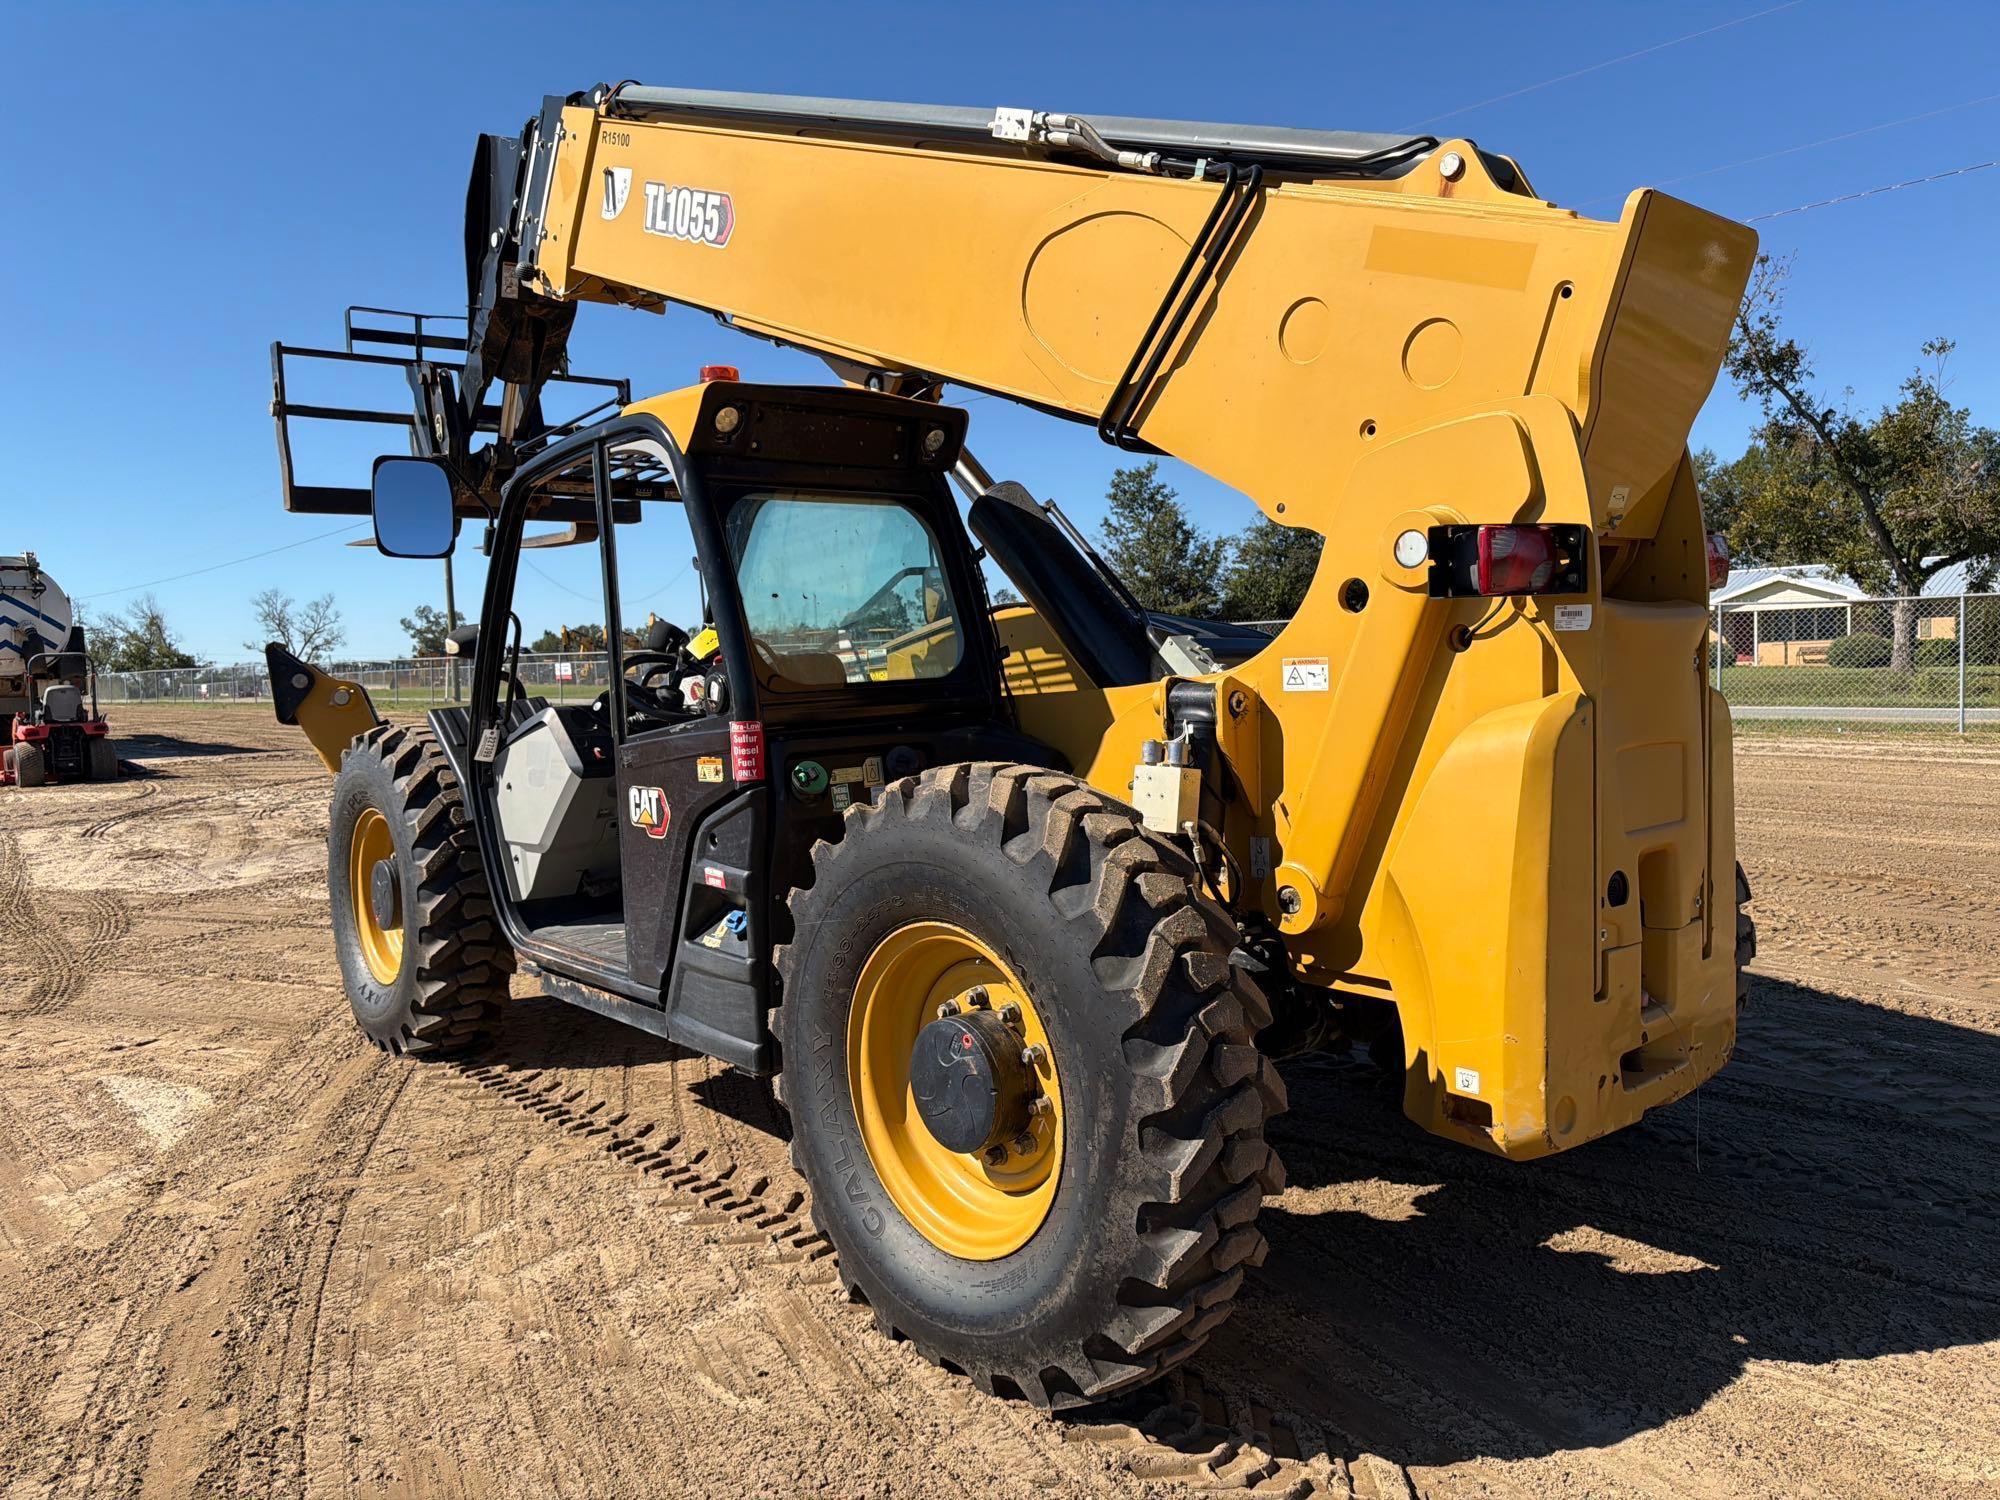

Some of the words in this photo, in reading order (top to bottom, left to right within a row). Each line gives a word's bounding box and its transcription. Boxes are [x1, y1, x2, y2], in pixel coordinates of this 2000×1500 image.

[602, 130, 630, 147] R15100
[645, 183, 721, 242] TL1055
[733, 734, 758, 743] Sulfur
[733, 745, 759, 755] Diesel
[737, 757, 756, 767] Fuel
[738, 769, 757, 777] ONLY
[629, 787, 659, 825] CAT
[811, 1024, 886, 1239] GALAXY
